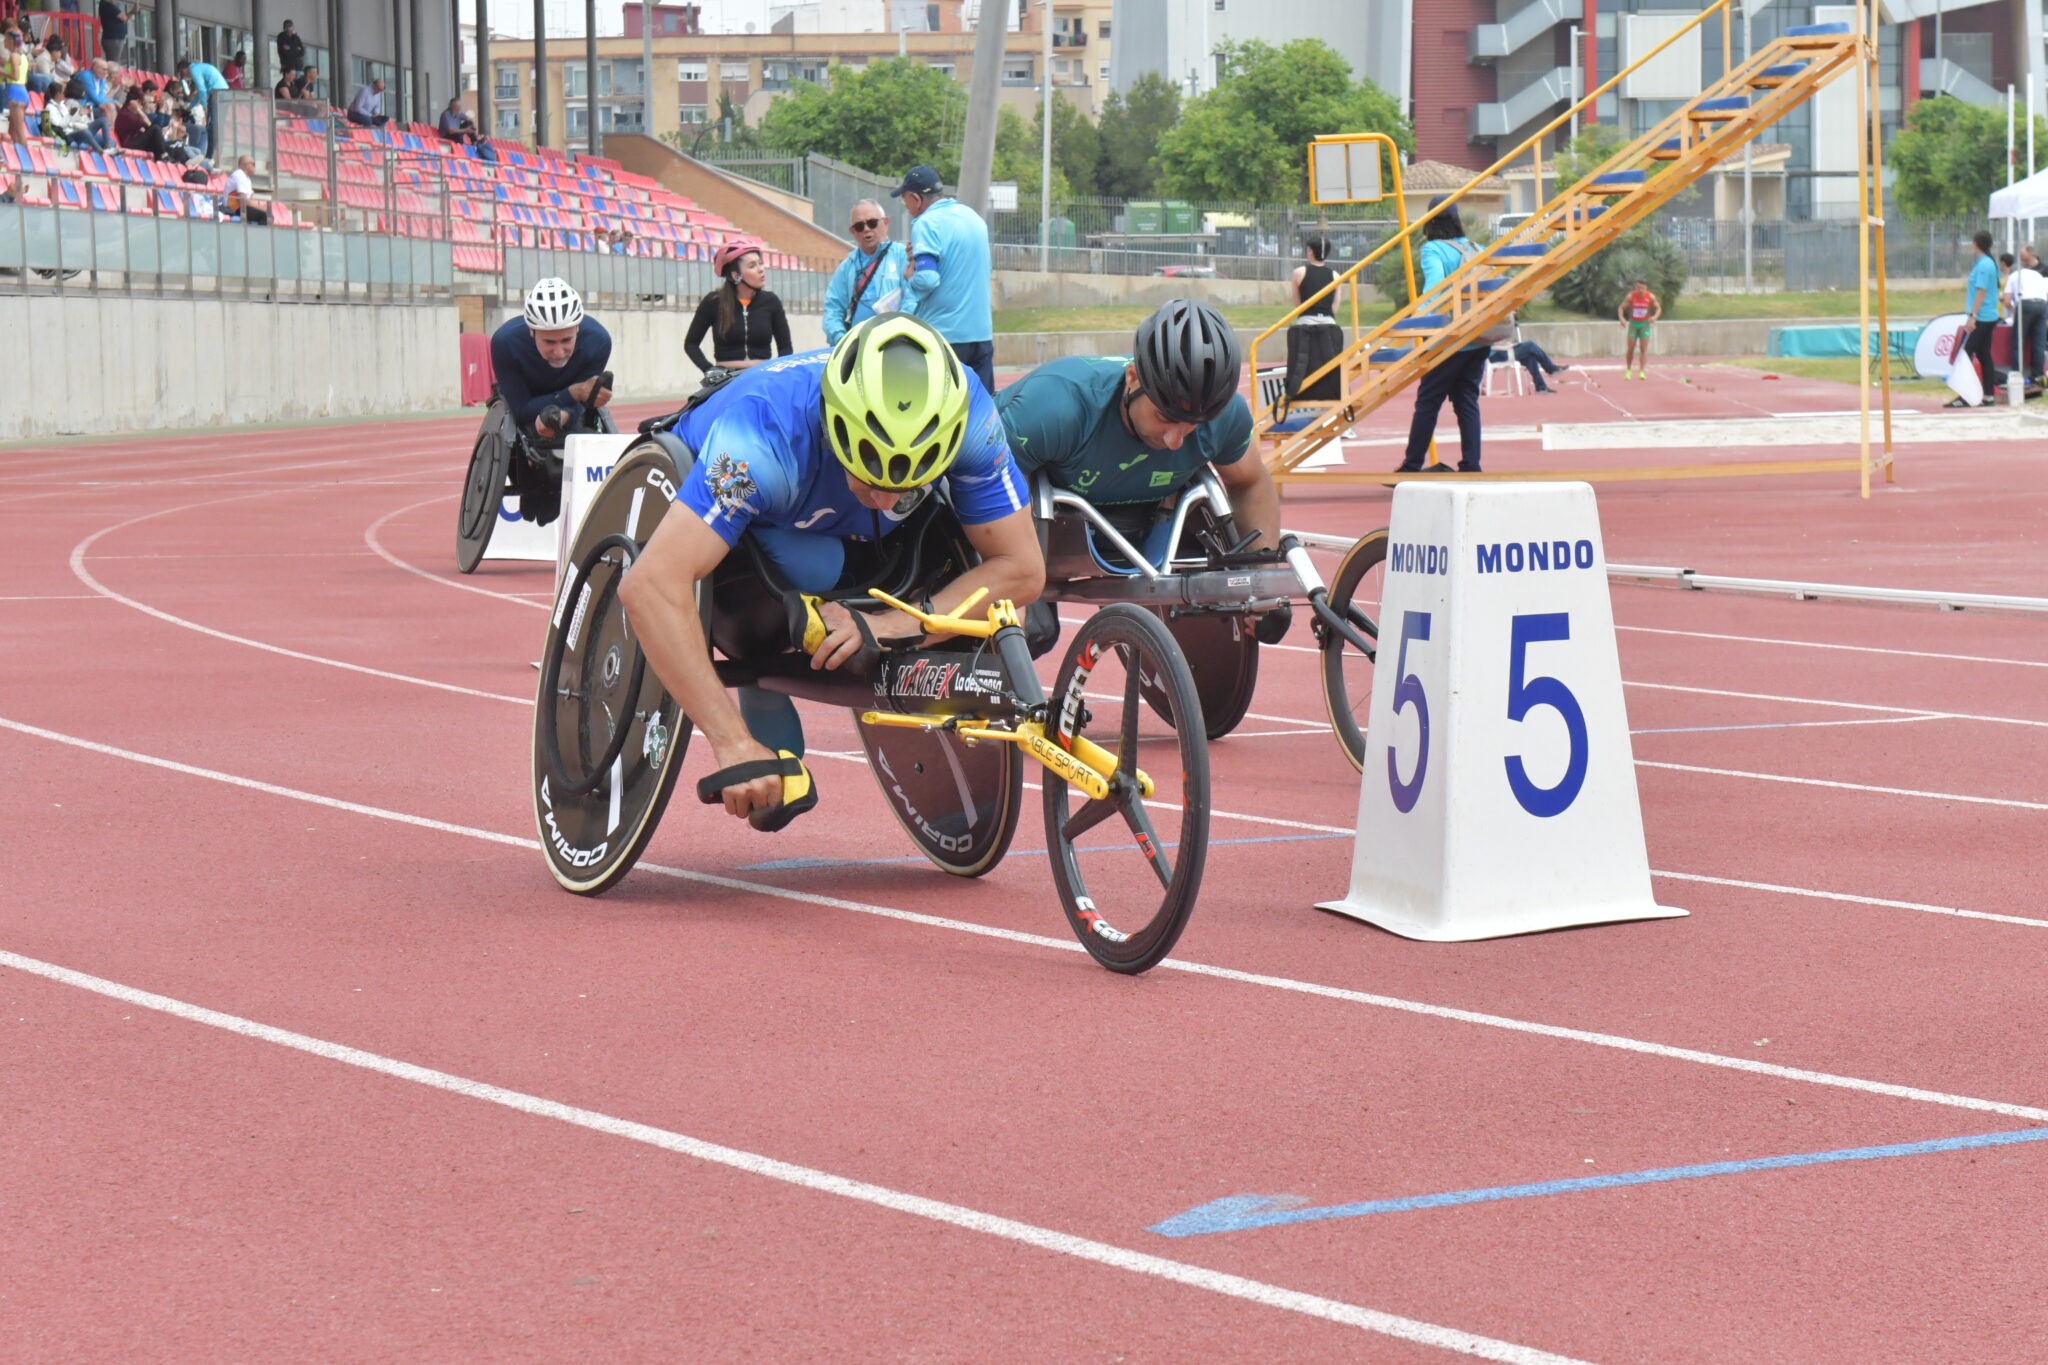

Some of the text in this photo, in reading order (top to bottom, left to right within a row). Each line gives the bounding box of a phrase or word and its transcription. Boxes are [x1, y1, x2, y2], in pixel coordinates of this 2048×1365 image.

[1391, 542, 1449, 576] MONDO
[1476, 539, 1594, 574] MONDO
[955, 672, 964, 692] La
[1387, 610, 1432, 814] 5
[1504, 612, 1589, 818] 5
[1030, 735, 1093, 785] ABLE SPORT
[541, 774, 608, 867] CORIMA
[878, 746, 973, 853] CORIMA
